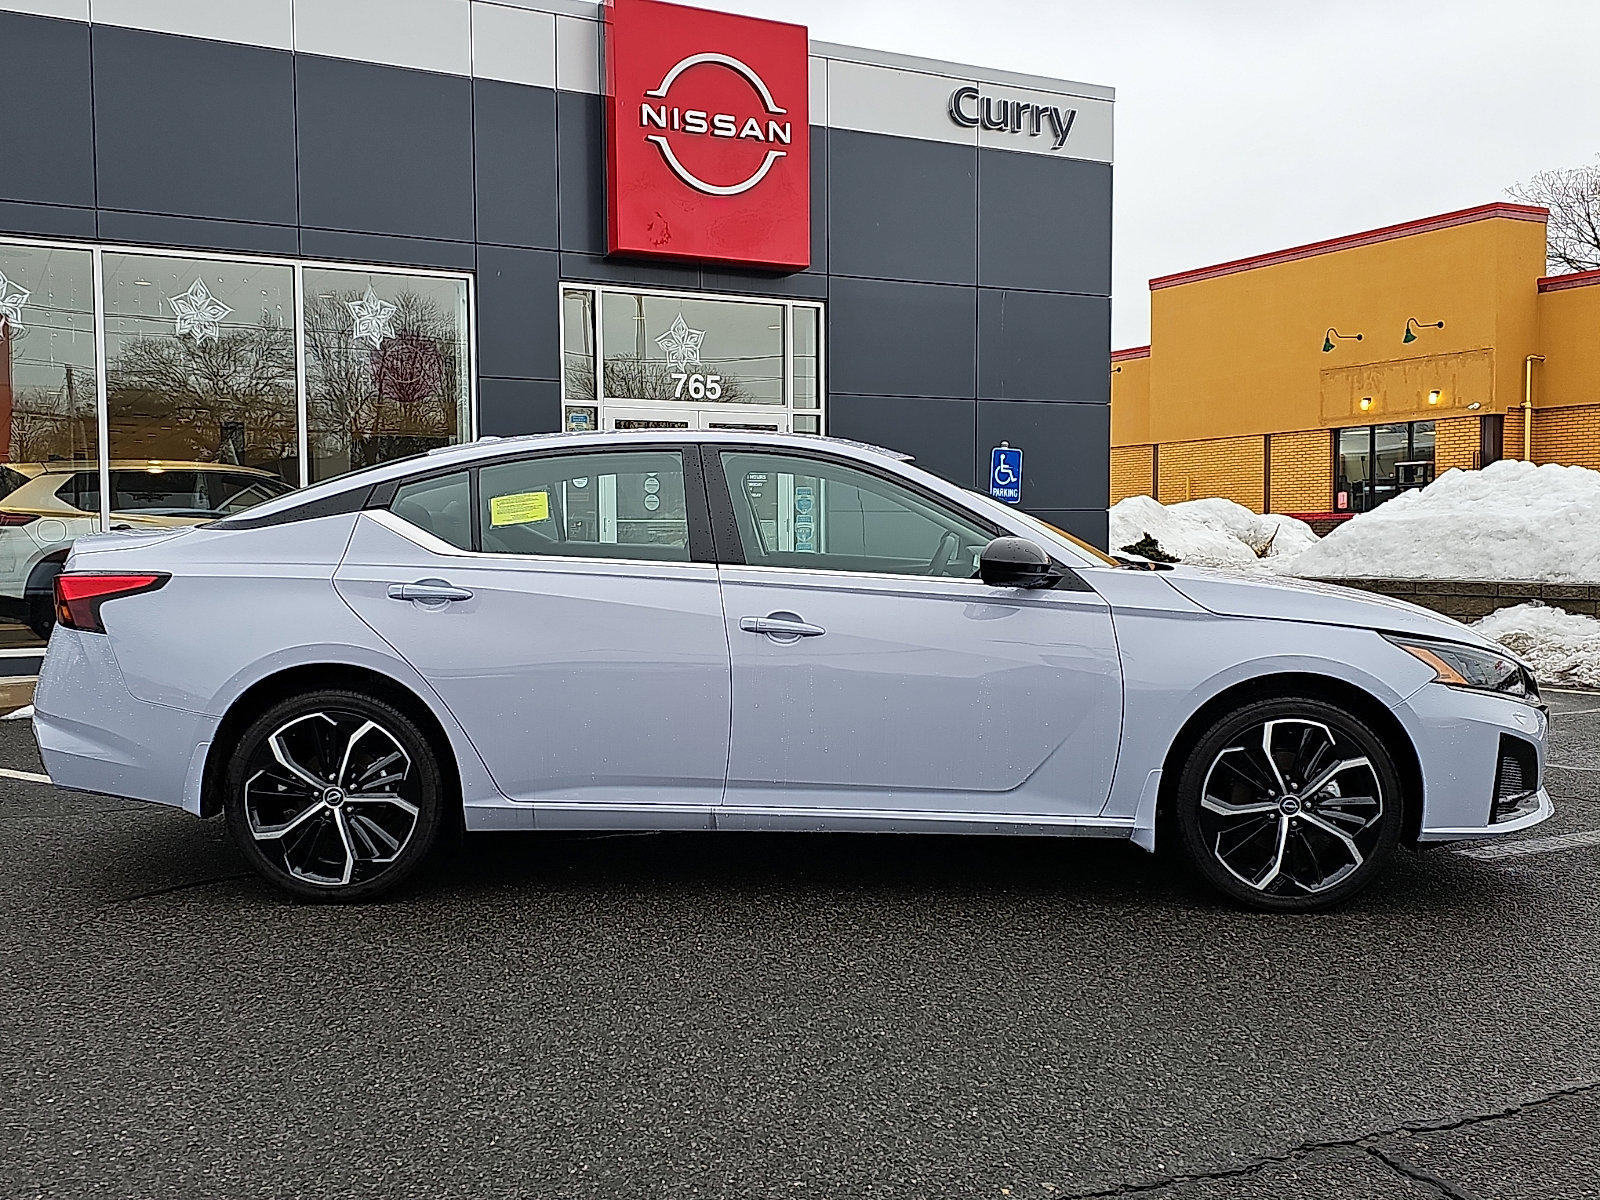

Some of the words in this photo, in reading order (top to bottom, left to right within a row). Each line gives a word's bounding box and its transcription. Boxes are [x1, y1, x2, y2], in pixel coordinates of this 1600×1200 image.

[640, 103, 791, 144] NISSAN
[949, 86, 1077, 150] Curry
[671, 373, 722, 400] 765
[992, 487, 1018, 498] PARKING
